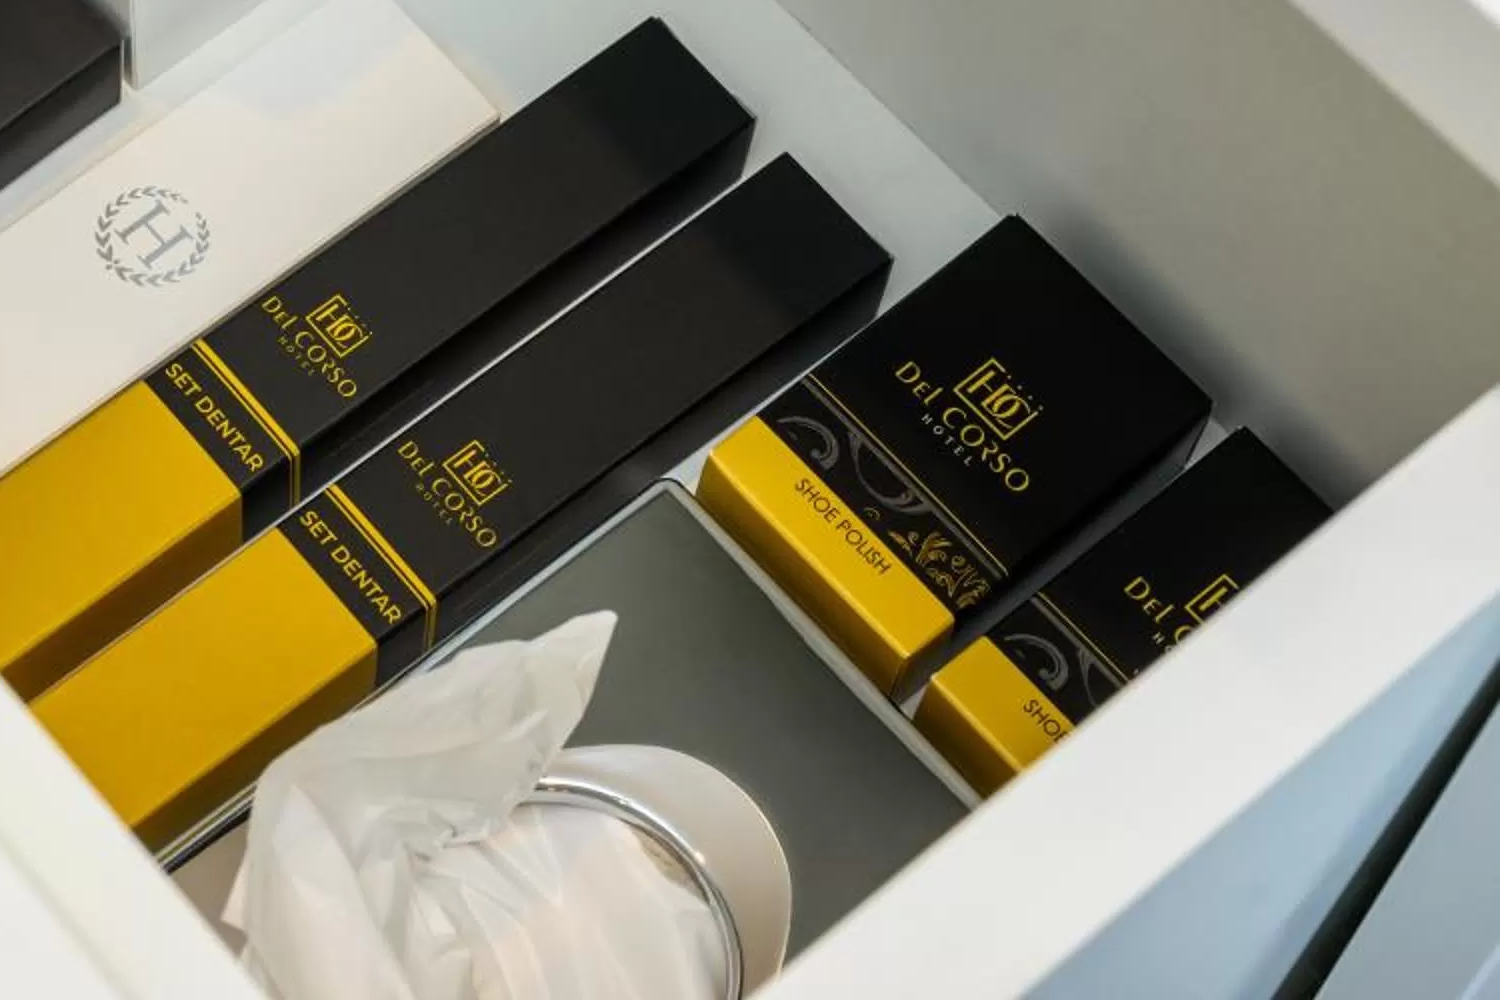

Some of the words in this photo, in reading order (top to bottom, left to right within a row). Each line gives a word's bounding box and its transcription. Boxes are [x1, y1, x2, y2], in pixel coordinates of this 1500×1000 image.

[294, 331, 358, 398] CORSO
[165, 363, 202, 396] SET
[195, 395, 264, 473] DENTAR
[920, 413, 973, 467] HOTEL
[942, 407, 1030, 492] CORSO
[431, 477, 498, 548] CORSO
[794, 477, 840, 524] SHOE
[836, 518, 894, 576] POLISH
[300, 510, 338, 546] SET
[330, 545, 402, 624] DENTAR
